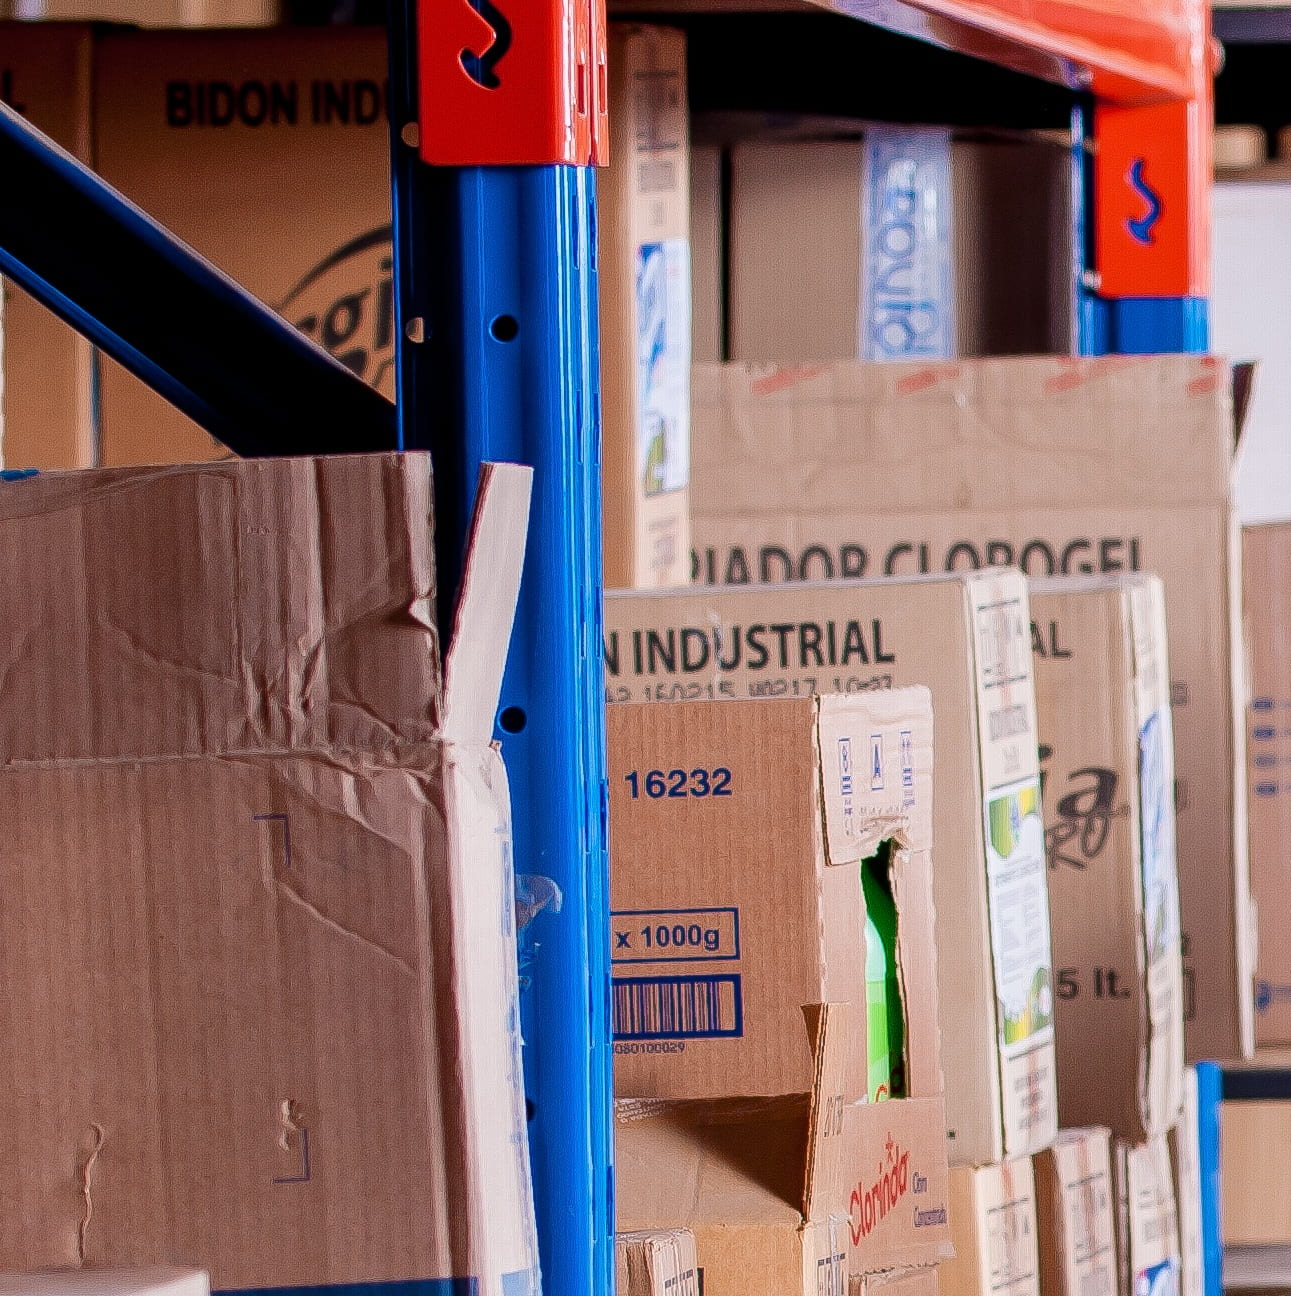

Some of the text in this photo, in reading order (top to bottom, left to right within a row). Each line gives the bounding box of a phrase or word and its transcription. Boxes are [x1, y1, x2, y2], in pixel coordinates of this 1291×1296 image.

[166, 80, 297, 126] BIDON
[633, 618, 897, 677] INDUSTRIAL
[625, 767, 733, 799] 16232
[616, 924, 720, 952] x 1000g
[848, 1143, 911, 1247] Clorinda
